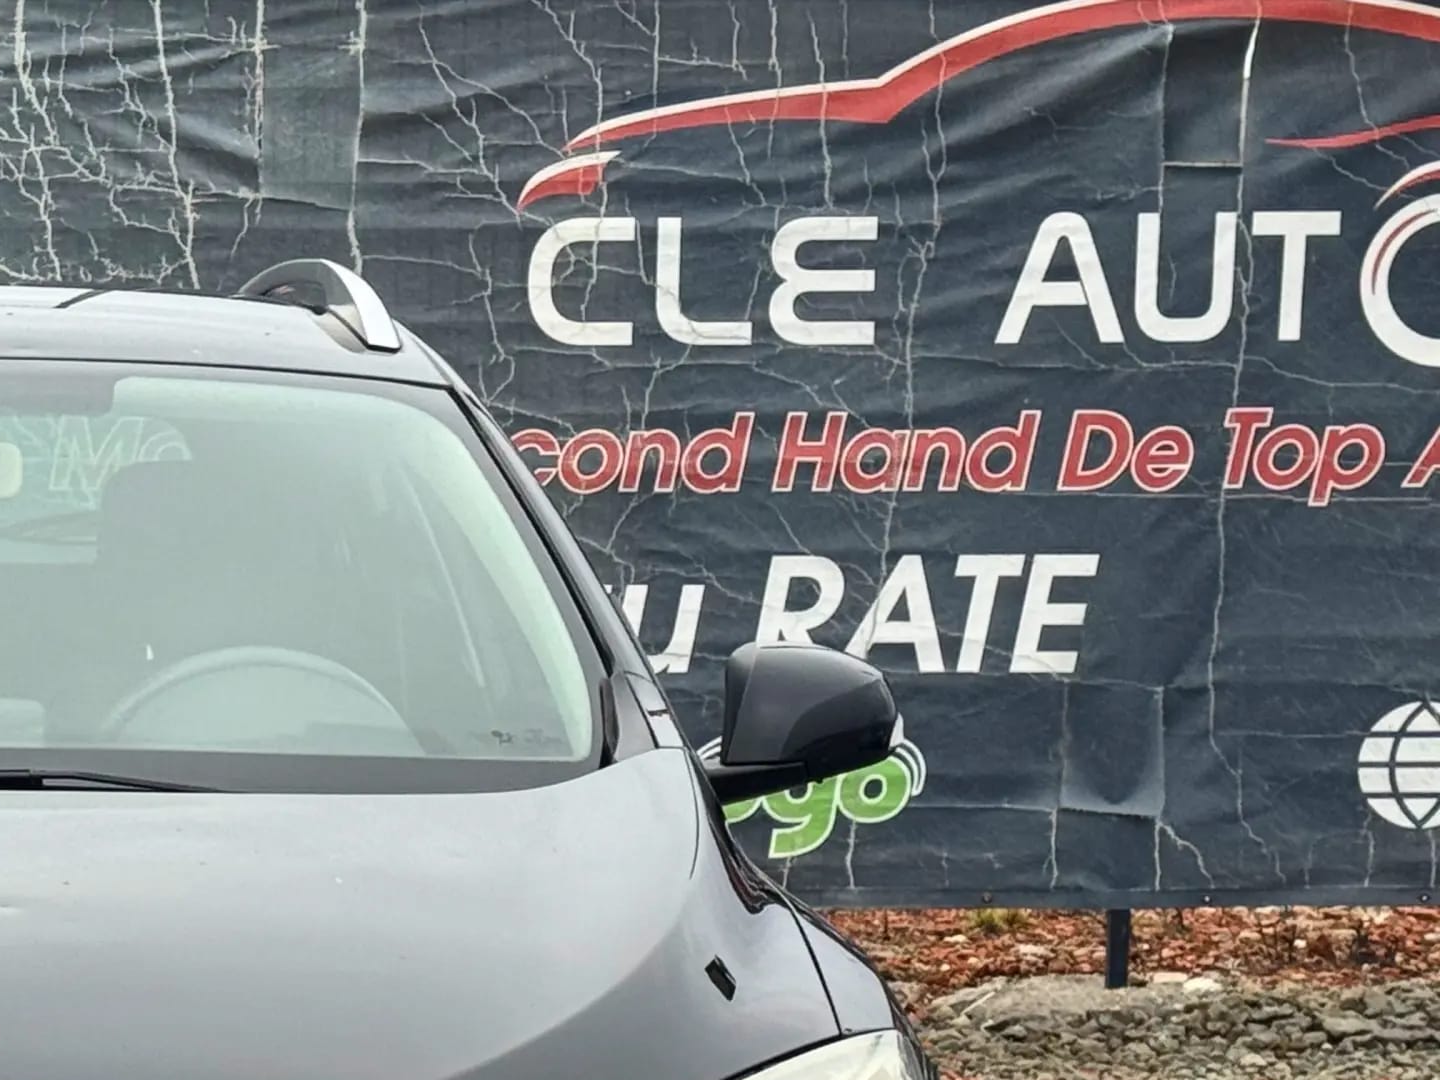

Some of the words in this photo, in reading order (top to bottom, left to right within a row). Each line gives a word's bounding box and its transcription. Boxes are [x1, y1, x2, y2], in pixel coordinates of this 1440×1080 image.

[526, 215, 879, 347] CLE
[770, 409, 1042, 493] Hand
[1056, 408, 1195, 493] De
[1223, 406, 1386, 507] Top
[756, 554, 1101, 674] RATE
